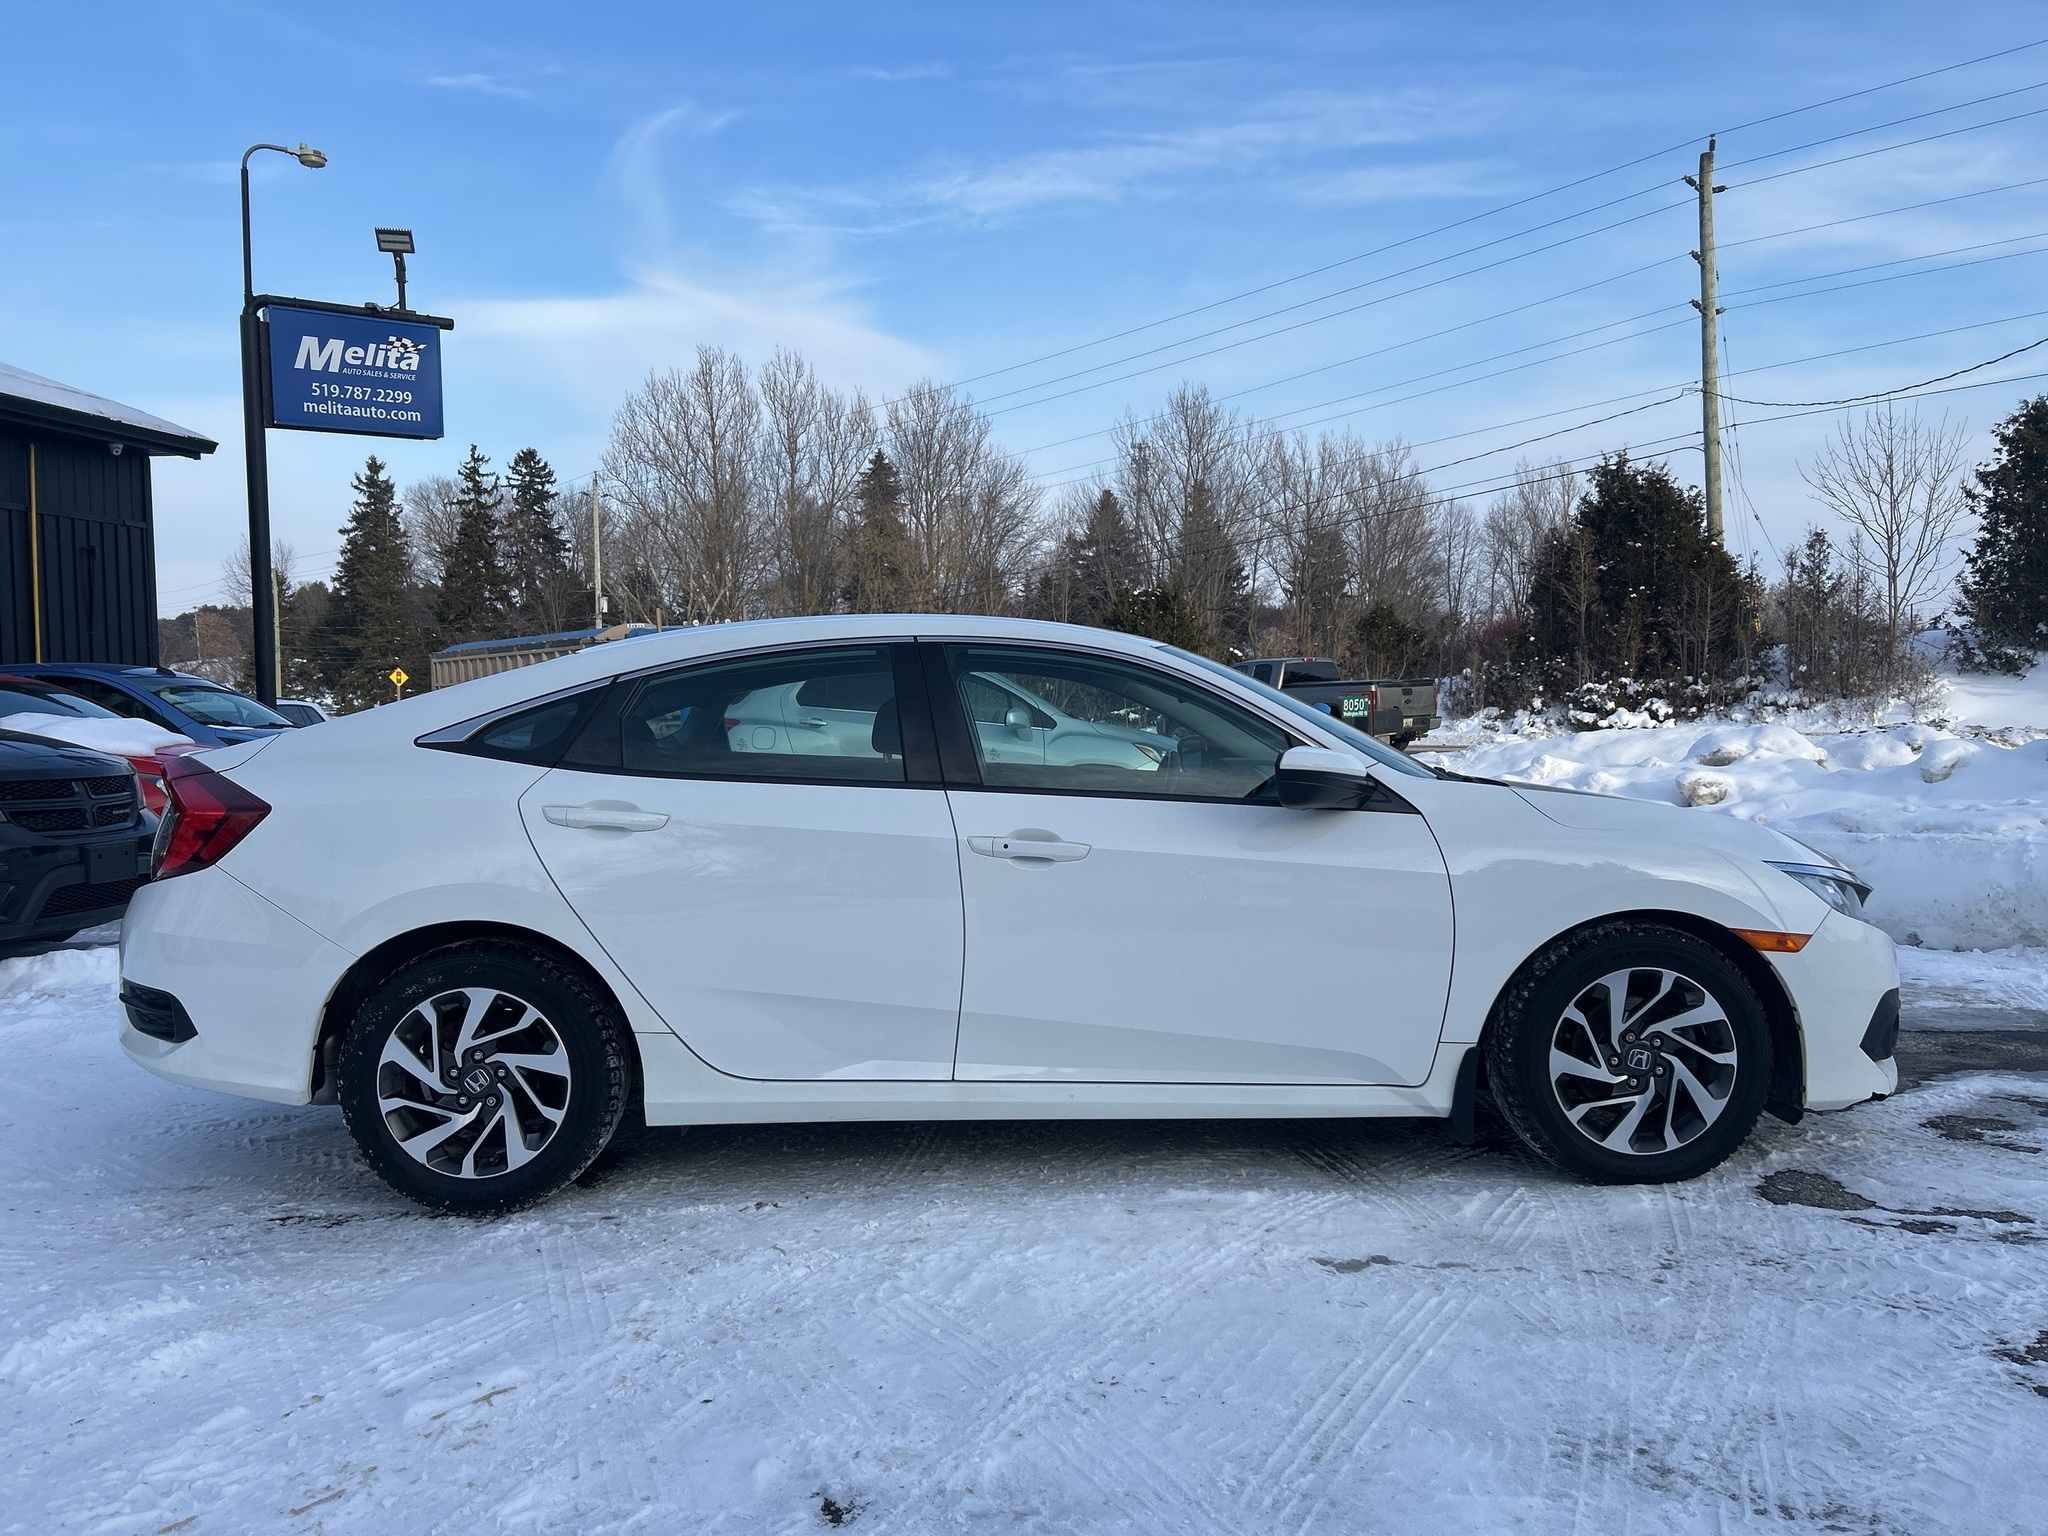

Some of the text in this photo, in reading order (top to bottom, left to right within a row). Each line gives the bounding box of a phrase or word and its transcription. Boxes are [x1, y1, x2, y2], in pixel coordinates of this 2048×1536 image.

[294, 335, 420, 373] Melita
[342, 367, 362, 375] AUTO
[362, 369, 383, 378] SALES
[389, 372, 416, 381] SERVICE
[311, 382, 412, 404] 519.787.2299
[303, 400, 421, 422] melitaauto.com
[1343, 699, 1364, 711] 8050
